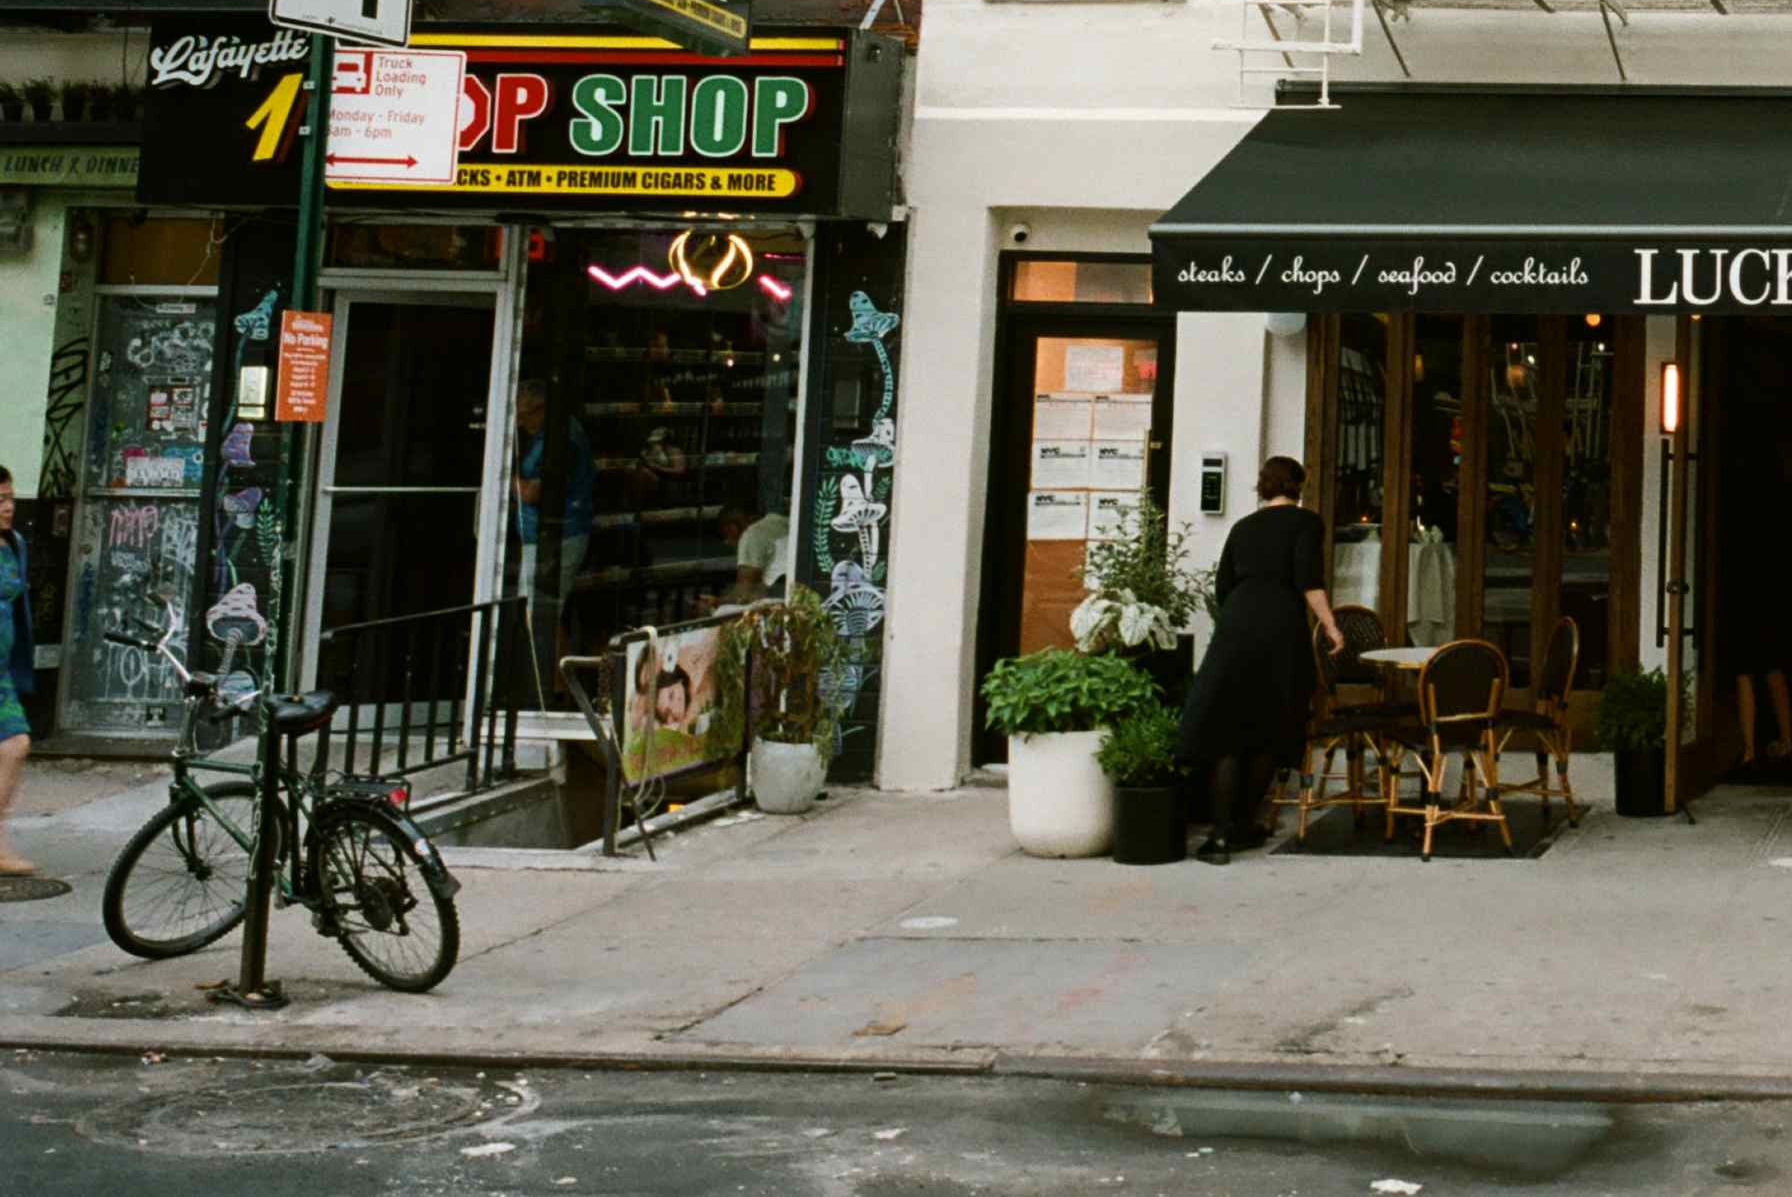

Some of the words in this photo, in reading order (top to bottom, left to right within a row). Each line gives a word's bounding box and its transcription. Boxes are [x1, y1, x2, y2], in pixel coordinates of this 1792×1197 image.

[151, 30, 310, 87] Lafayette
[378, 56, 413, 69] Truck
[376, 70, 427, 85] Loading
[375, 83, 405, 98] Only
[246, 73, 303, 162] 1
[569, 74, 810, 158] SHOP
[387, 110, 426, 125] Friday
[3, 155, 65, 172] LUNCH
[87, 155, 139, 173] DINNE
[505, 170, 542, 188] ATM
[556, 170, 637, 190] PREMIUM
[641, 171, 706, 191] CIGARS
[709, 174, 722, 191] &
[727, 173, 776, 192] MORE
[1177, 256, 1246, 284] steaks
[1281, 255, 1341, 295] chops
[1377, 256, 1457, 295] seafood
[1490, 257, 1589, 285] cocktails
